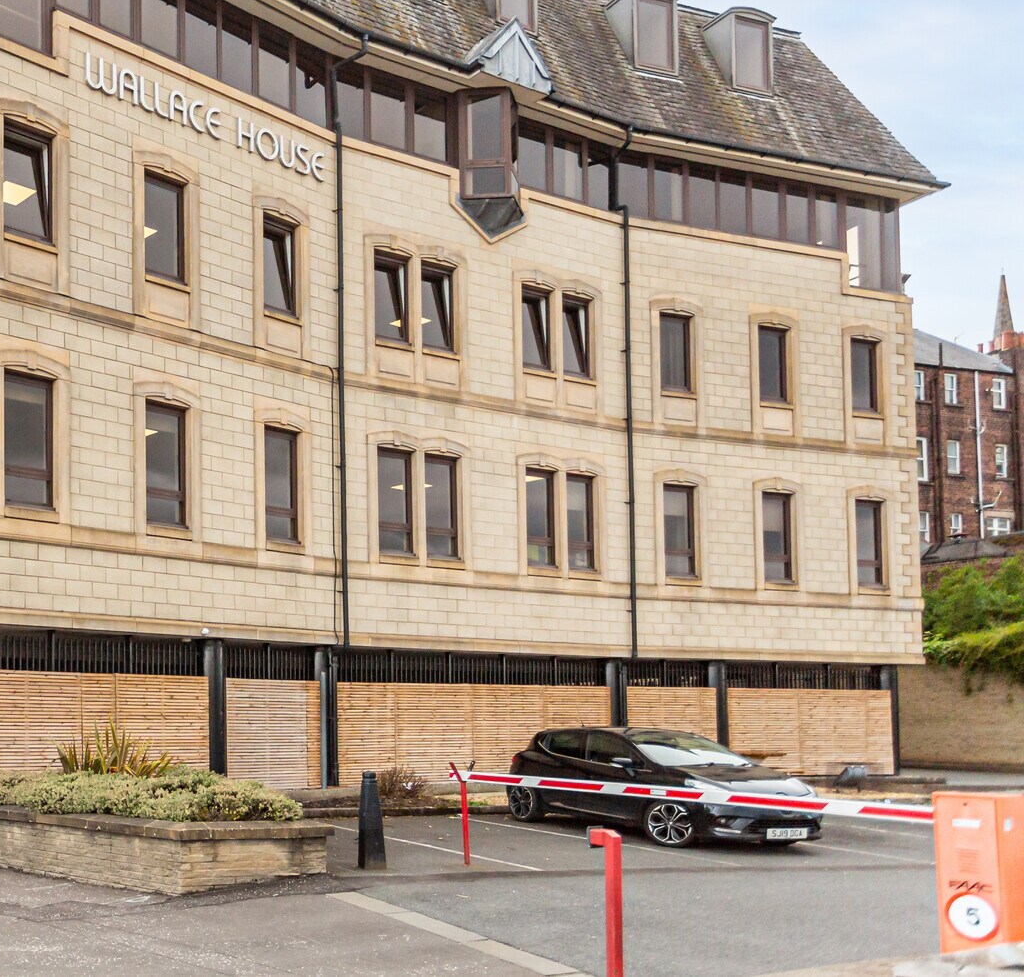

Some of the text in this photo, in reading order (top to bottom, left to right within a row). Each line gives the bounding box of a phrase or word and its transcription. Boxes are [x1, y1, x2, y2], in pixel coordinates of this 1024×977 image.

[85, 51, 325, 182] WALLACE HOUSE
[966, 907, 980, 926] 5
